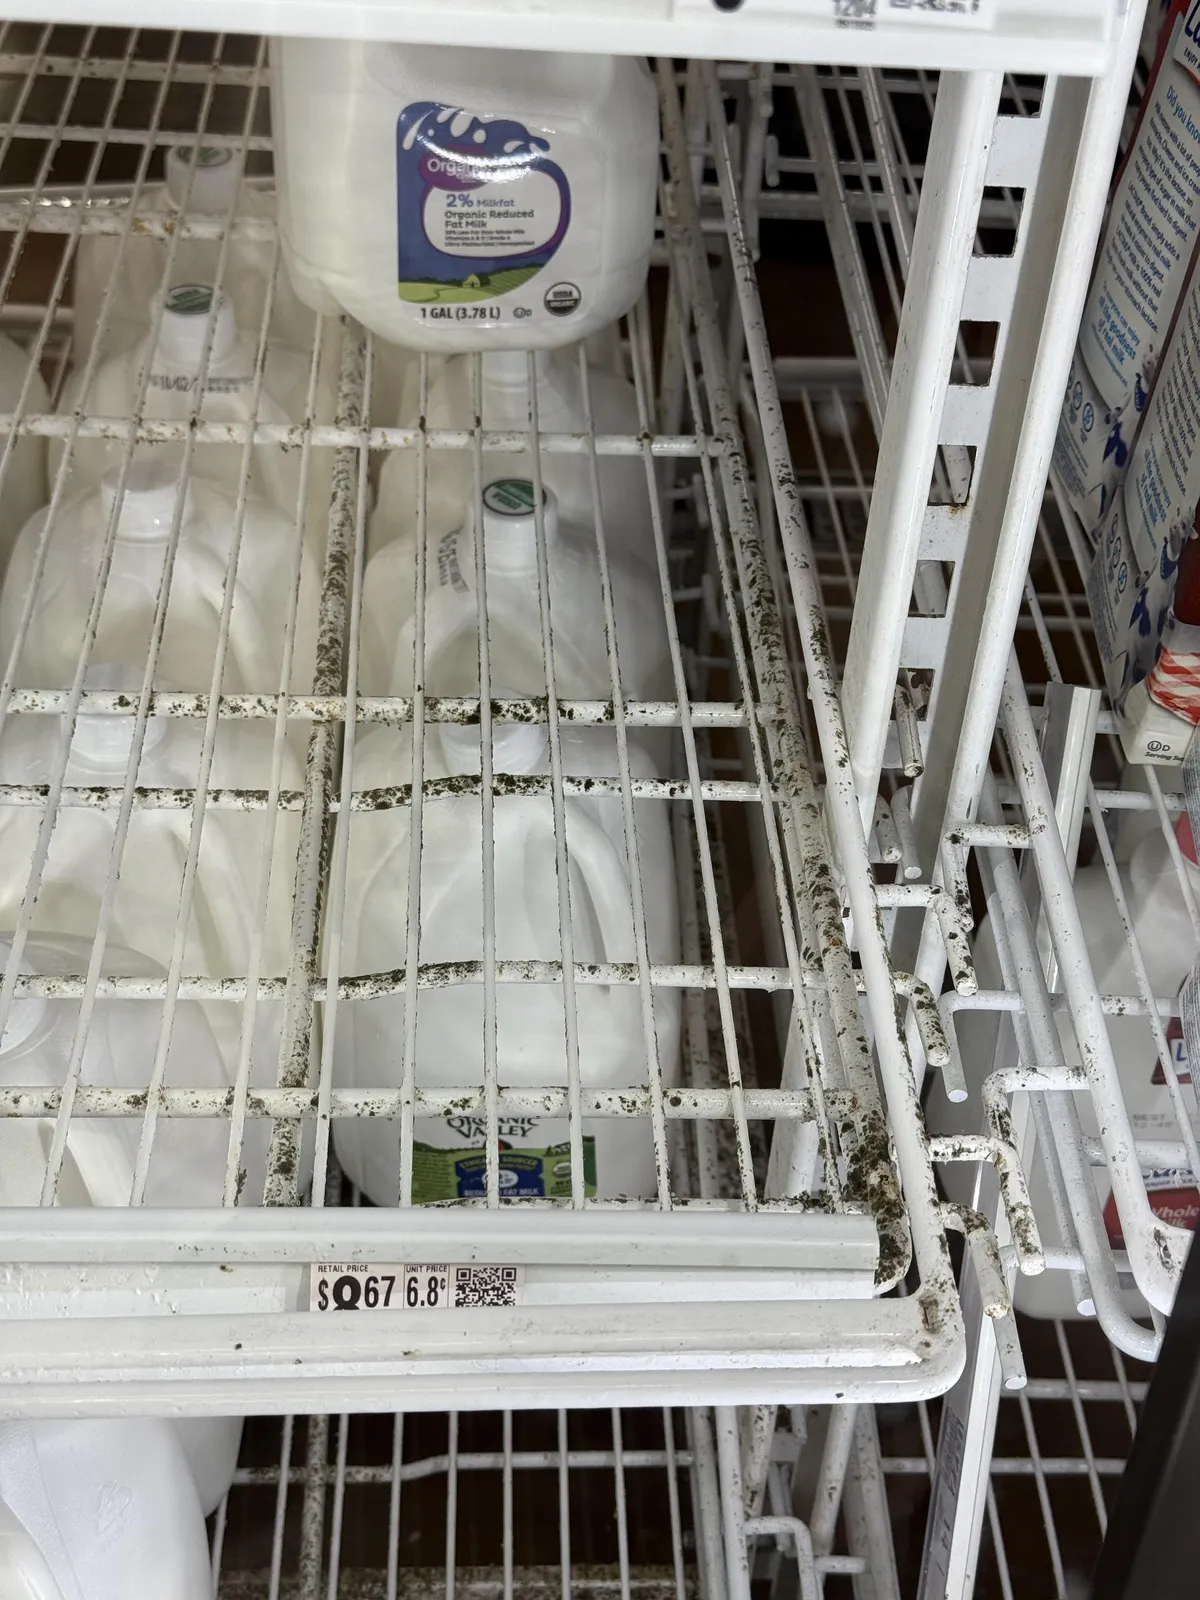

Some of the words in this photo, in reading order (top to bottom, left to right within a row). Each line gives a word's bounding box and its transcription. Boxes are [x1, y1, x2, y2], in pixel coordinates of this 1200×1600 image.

[446, 193, 474, 207] 2%
[445, 210, 487, 220] Organic
[489, 209, 534, 218] Reduced
[445, 221, 463, 229] Fat
[465, 220, 487, 229] Milk
[420, 307, 427, 319] 1
[430, 307, 454, 319] GAL
[456, 307, 487, 321] (3.78
[489, 307, 501, 321] L)
[1145, 751, 1172, 760] Serving
[447, 1116, 540, 1129] ORANIC
[456, 1126, 533, 1138] VALEY
[1167, 1217, 1187, 1228] ilk
[318, 1264, 344, 1273] RETAIL
[347, 1264, 368, 1273] PRICE
[406, 1265, 423, 1273] UNIT
[425, 1265, 448, 1273] PRICE
